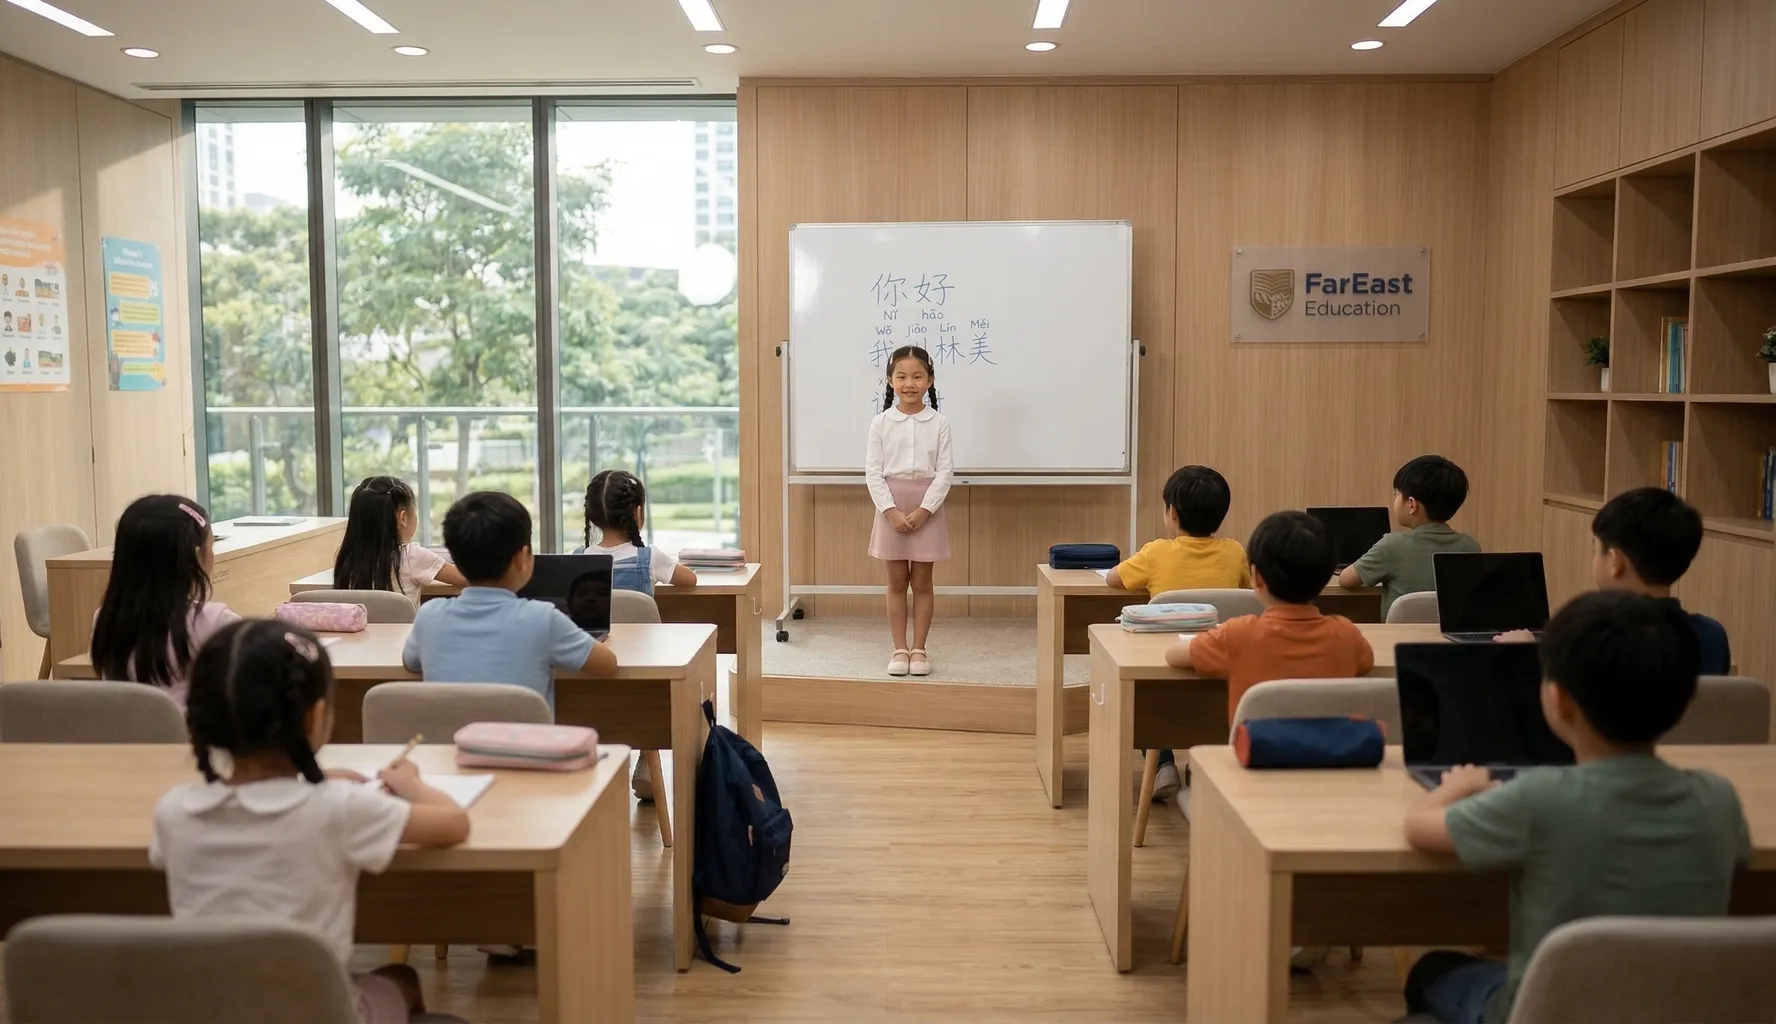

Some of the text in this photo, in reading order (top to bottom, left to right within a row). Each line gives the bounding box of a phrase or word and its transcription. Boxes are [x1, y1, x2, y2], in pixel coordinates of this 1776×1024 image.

[870, 273, 955, 307] 你好
[1305, 273, 1413, 294] FarEast
[1305, 300, 1401, 316] Education
[940, 322, 957, 333] Lín
[869, 332, 999, 368] 我林美
